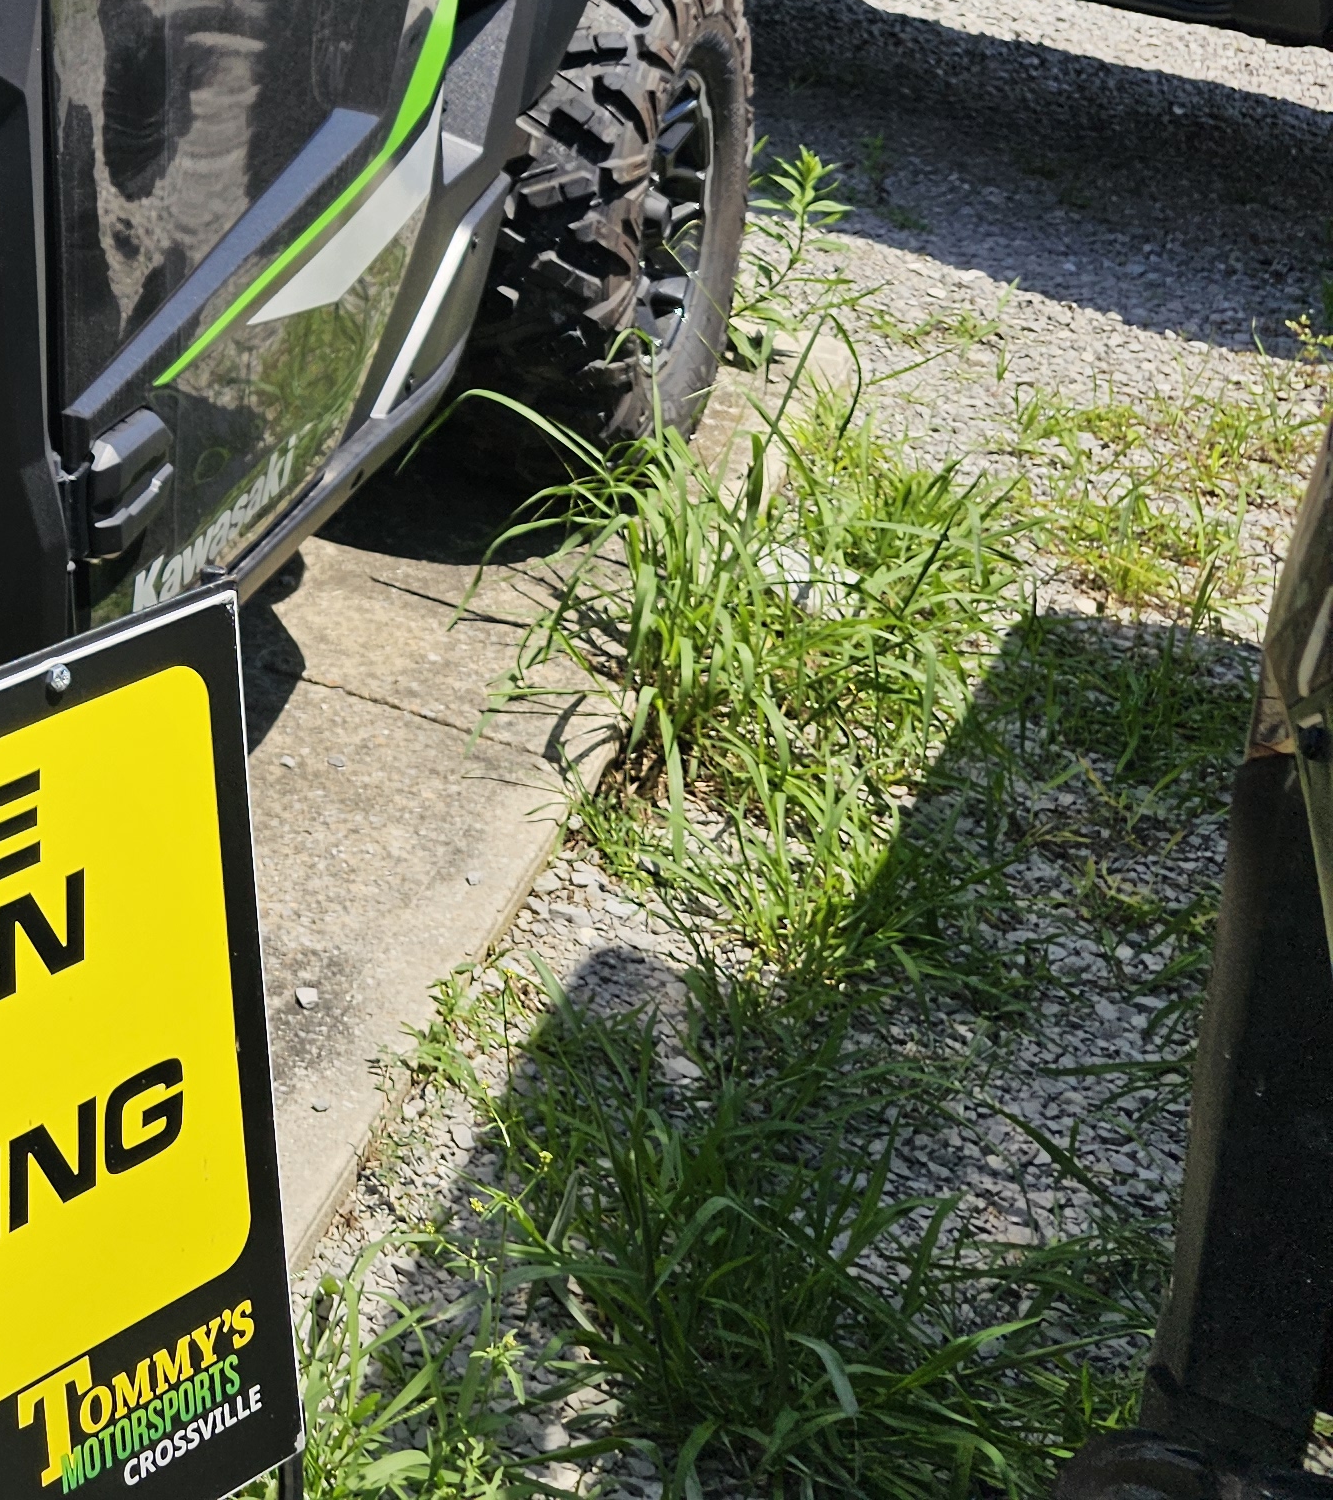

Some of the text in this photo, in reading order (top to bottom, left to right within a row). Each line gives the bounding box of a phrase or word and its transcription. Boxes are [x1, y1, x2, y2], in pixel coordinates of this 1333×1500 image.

[133, 433, 298, 612] Kawasaki
[17, 1299, 255, 1487] TOMMY'S
[61, 1354, 241, 1495] MOTORSPORTS
[123, 1384, 263, 1487] CROSSVILLE
